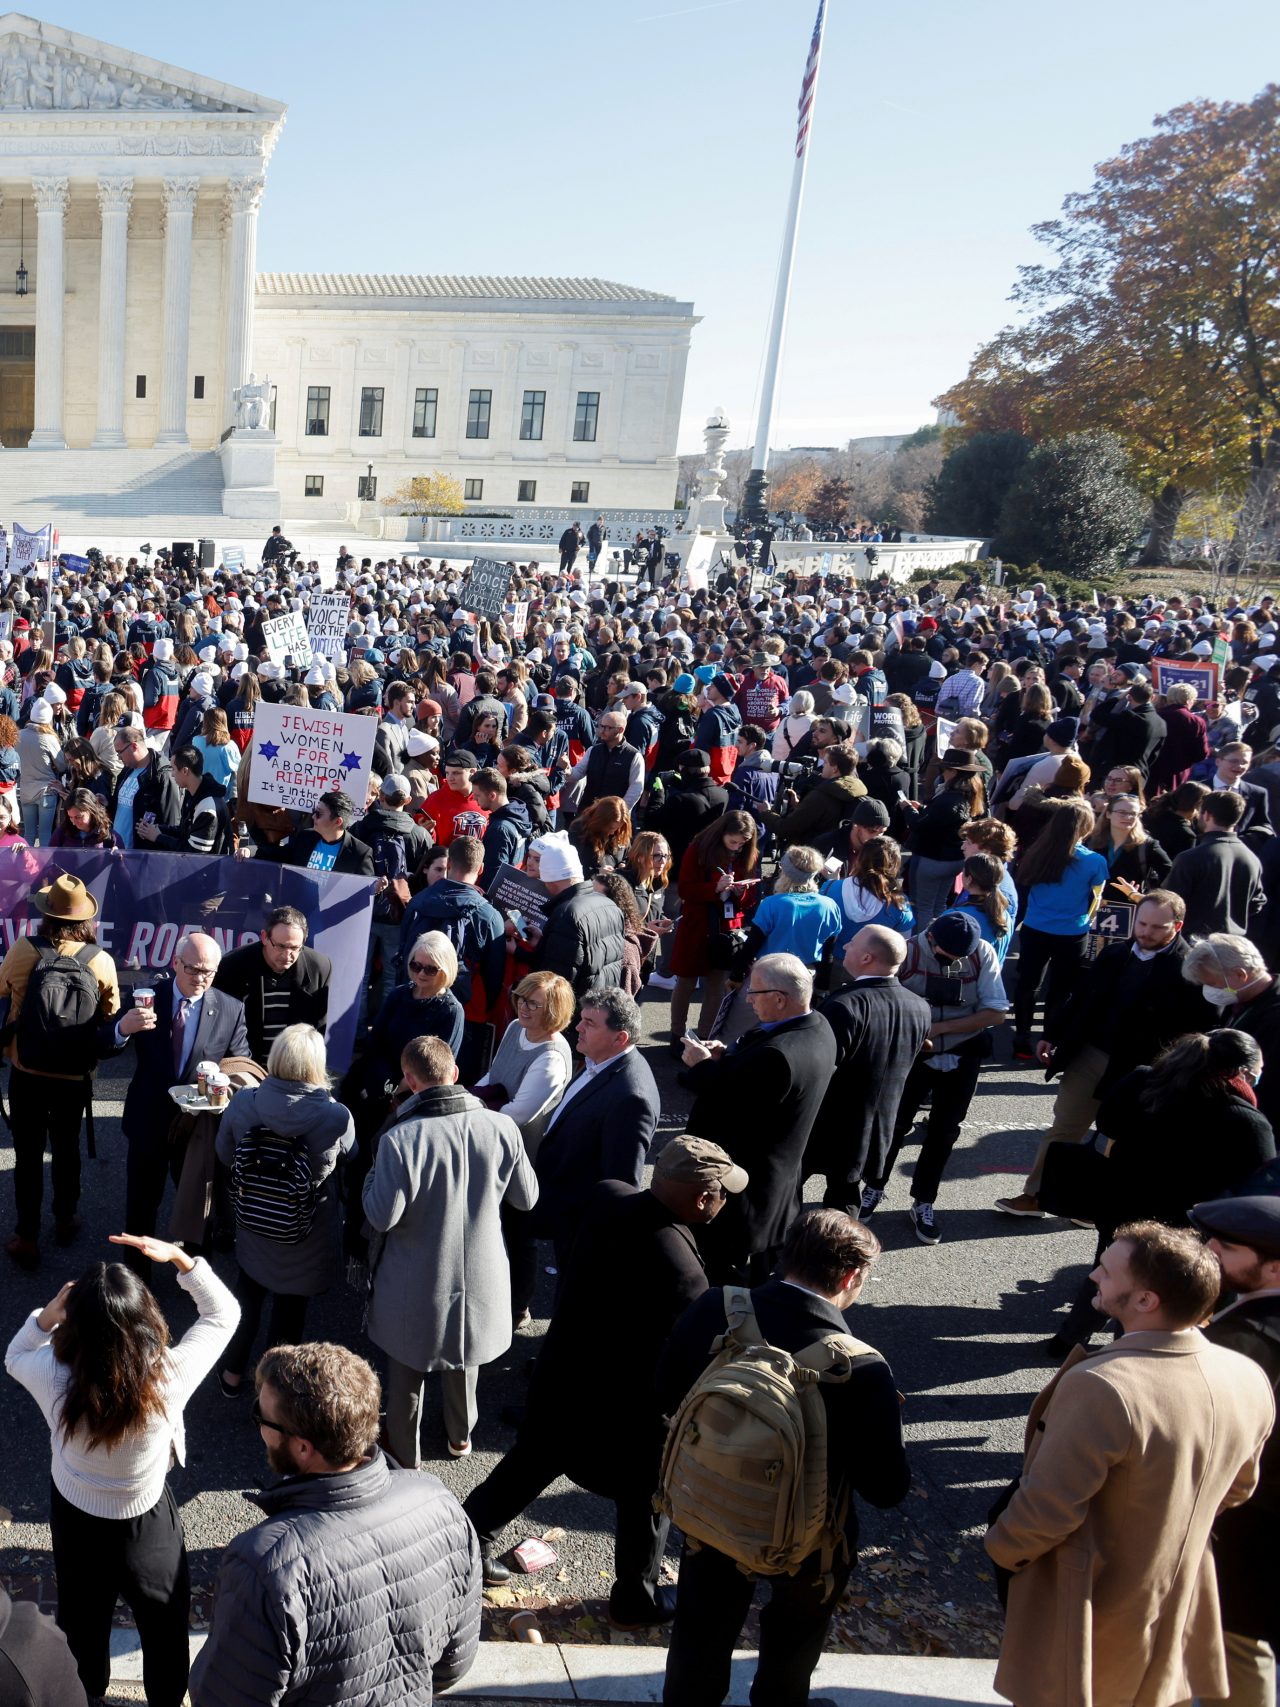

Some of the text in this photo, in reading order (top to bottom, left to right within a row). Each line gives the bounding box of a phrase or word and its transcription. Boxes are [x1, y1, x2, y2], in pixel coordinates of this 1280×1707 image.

[30, 142, 74, 153] UNDER
[474, 558, 512, 576] I AM THE
[472, 570, 508, 590] VOICE
[469, 582, 506, 600] FOR THE
[312, 595, 350, 608] I AM THE
[464, 592, 504, 614] VOICELESS
[263, 614, 295, 636] EVERY
[310, 608, 347, 626] VOICE
[272, 626, 305, 649] LIFE
[308, 625, 345, 637] FOR THE
[287, 640, 307, 654] HAS
[843, 710, 862, 724] Life
[282, 716, 344, 737] JEWISH
[280, 732, 344, 754] WOMEN
[297, 748, 328, 764] FOR
[272, 759, 347, 781] ABORTION
[261, 782, 285, 794] It's
[300, 788, 319, 799] the
[276, 771, 341, 792] RIGHTS
[503, 896, 520, 908] PURSUIT
[517, 891, 532, 902] HIGHER
[529, 891, 548, 903] UNBORN
